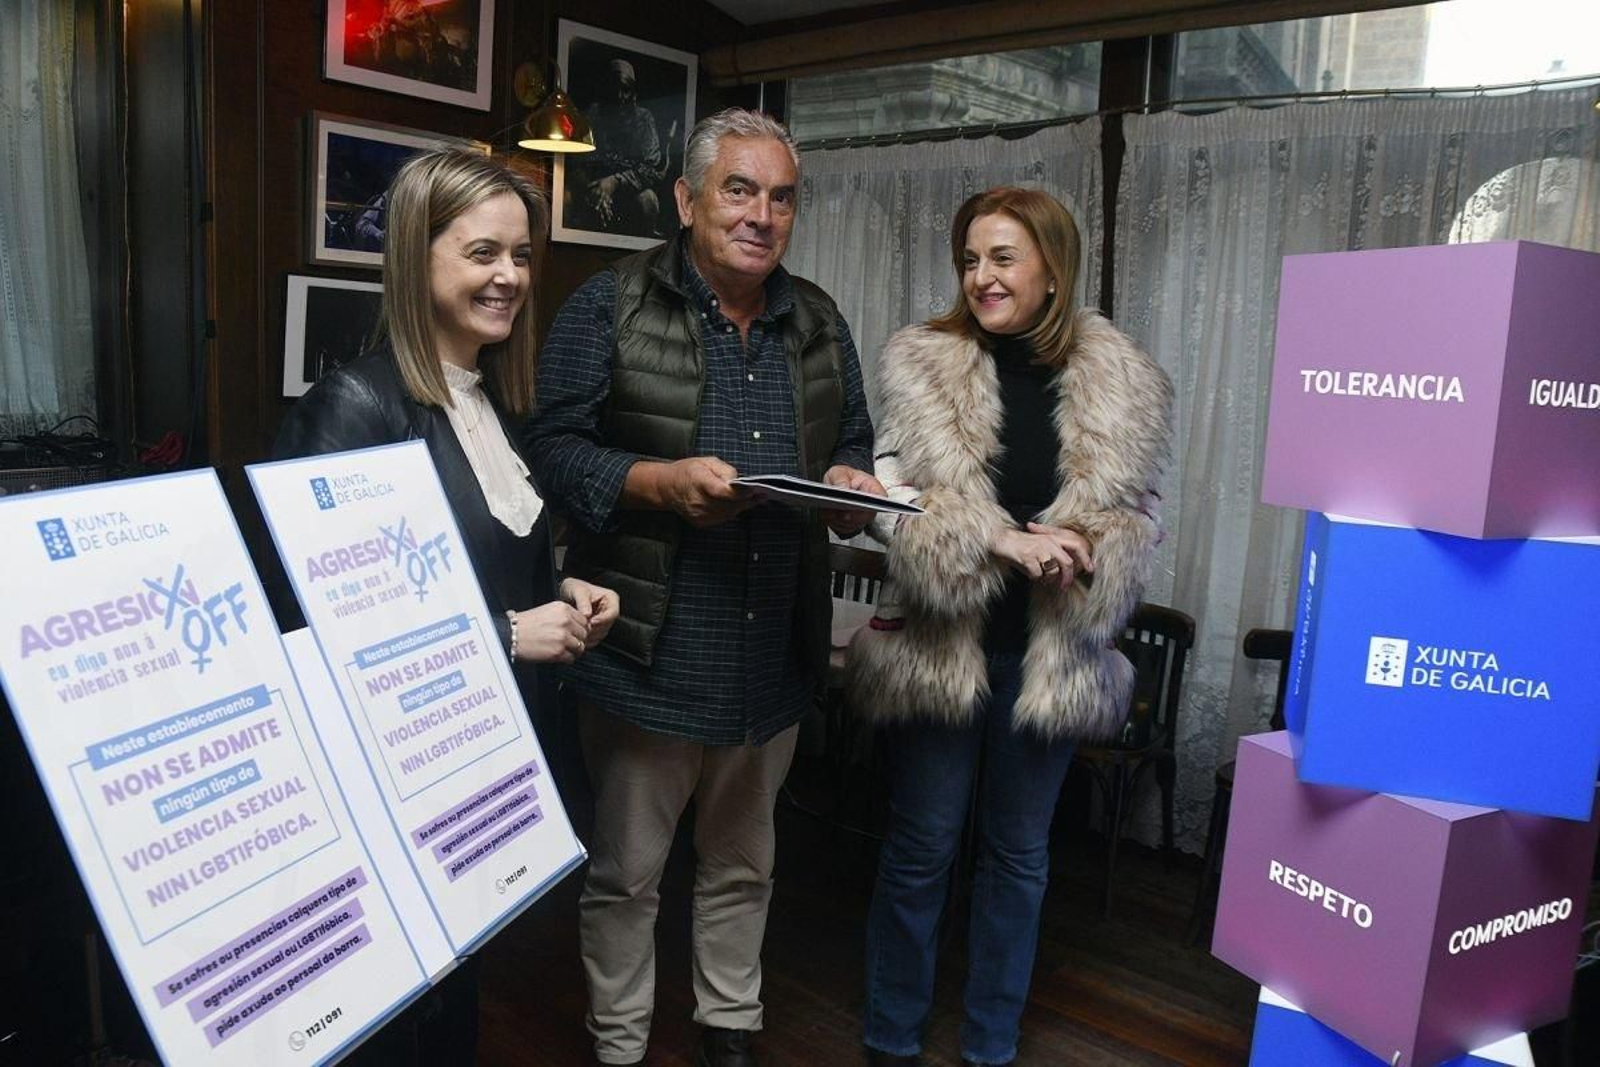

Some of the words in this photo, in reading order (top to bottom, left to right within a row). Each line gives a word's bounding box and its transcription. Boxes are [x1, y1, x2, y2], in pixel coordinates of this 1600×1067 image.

[1300, 369, 1465, 403] TOLERANCIA
[331, 474, 368, 489] XUNTA
[336, 491, 351, 503] DE
[353, 482, 395, 501] GALICIA
[73, 512, 130, 533] XUNTA
[77, 535, 100, 552] DE
[105, 523, 170, 546] GALICIA
[333, 595, 375, 619] violencia
[48, 666, 69, 682] eu
[74, 651, 108, 673] digo
[116, 643, 141, 661] non
[58, 668, 128, 703] violencia
[134, 649, 181, 678] sexual
[363, 647, 390, 663] Neste
[366, 668, 404, 697] NON
[403, 662, 423, 681] SE
[424, 640, 478, 674] ADMITE
[1414, 646, 1499, 671] XUNTA
[433, 682, 450, 695] tipo
[450, 674, 462, 686] de
[1411, 667, 1442, 688] DE
[1450, 671, 1551, 700] GALICIA
[101, 735, 147, 760] Neste
[147, 695, 255, 743] establecemento
[383, 707, 451, 748] VIOLENCIA
[452, 685, 498, 716] SEXUAL
[101, 763, 164, 806] NON
[164, 752, 195, 780] SE
[199, 718, 281, 768] ADMITE
[400, 752, 426, 776] NIN
[424, 714, 505, 760] LGBTIFÓBICA.
[159, 783, 210, 817] ningún
[210, 774, 237, 794] tipo
[238, 766, 255, 781] de
[122, 808, 237, 873] VIOLENCIA
[239, 776, 306, 819] SEXUAL
[146, 878, 189, 907] NIN
[189, 811, 318, 885] LGBTIFÓBICA.
[1268, 859, 1373, 929] RESPETO
[168, 982, 184, 995] Se
[184, 961, 218, 987] sofres
[219, 952, 233, 965] ou
[233, 918, 288, 959] presencias
[288, 893, 329, 922] calquera
[328, 882, 345, 899] tipo
[345, 875, 357, 889] de
[1448, 897, 1573, 955] COMPROMISO
[203, 973, 250, 1009] agresión
[250, 951, 285, 979] sexual
[285, 944, 297, 958] ou
[216, 1015, 240, 1037] pide
[241, 992, 274, 1018] axuda
[273, 984, 287, 996] ao
[286, 958, 323, 990] persoal
[322, 951, 335, 966] da
[334, 933, 362, 955] barra.
